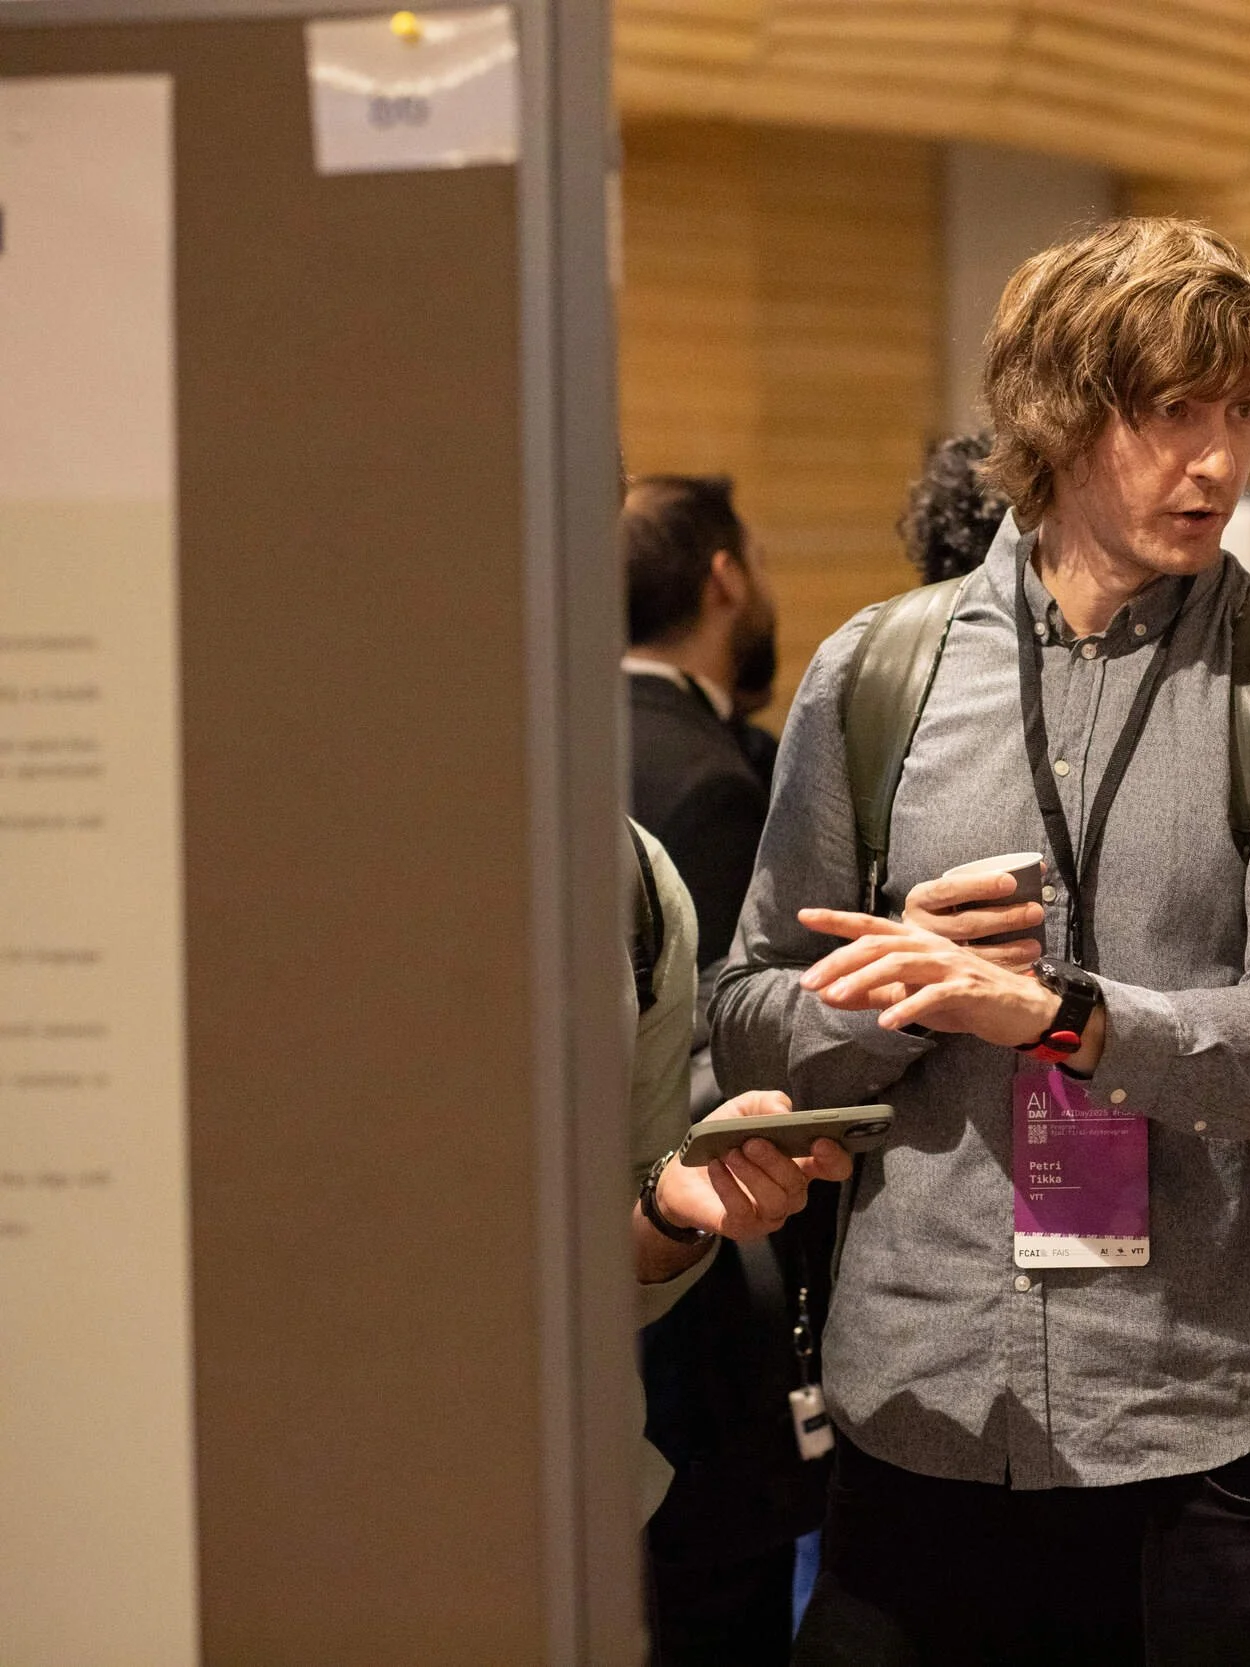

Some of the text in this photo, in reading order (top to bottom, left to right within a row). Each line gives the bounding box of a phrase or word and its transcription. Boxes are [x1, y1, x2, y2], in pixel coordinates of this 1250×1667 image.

[1027, 1091, 1046, 1109] AI
[1028, 1110, 1048, 1119] DAY
[1029, 1161, 1062, 1170] Petri
[1029, 1174, 1062, 1184] Tikka
[1019, 1249, 1040, 1257] FCAI
[1131, 1247, 1145, 1255] VTT
